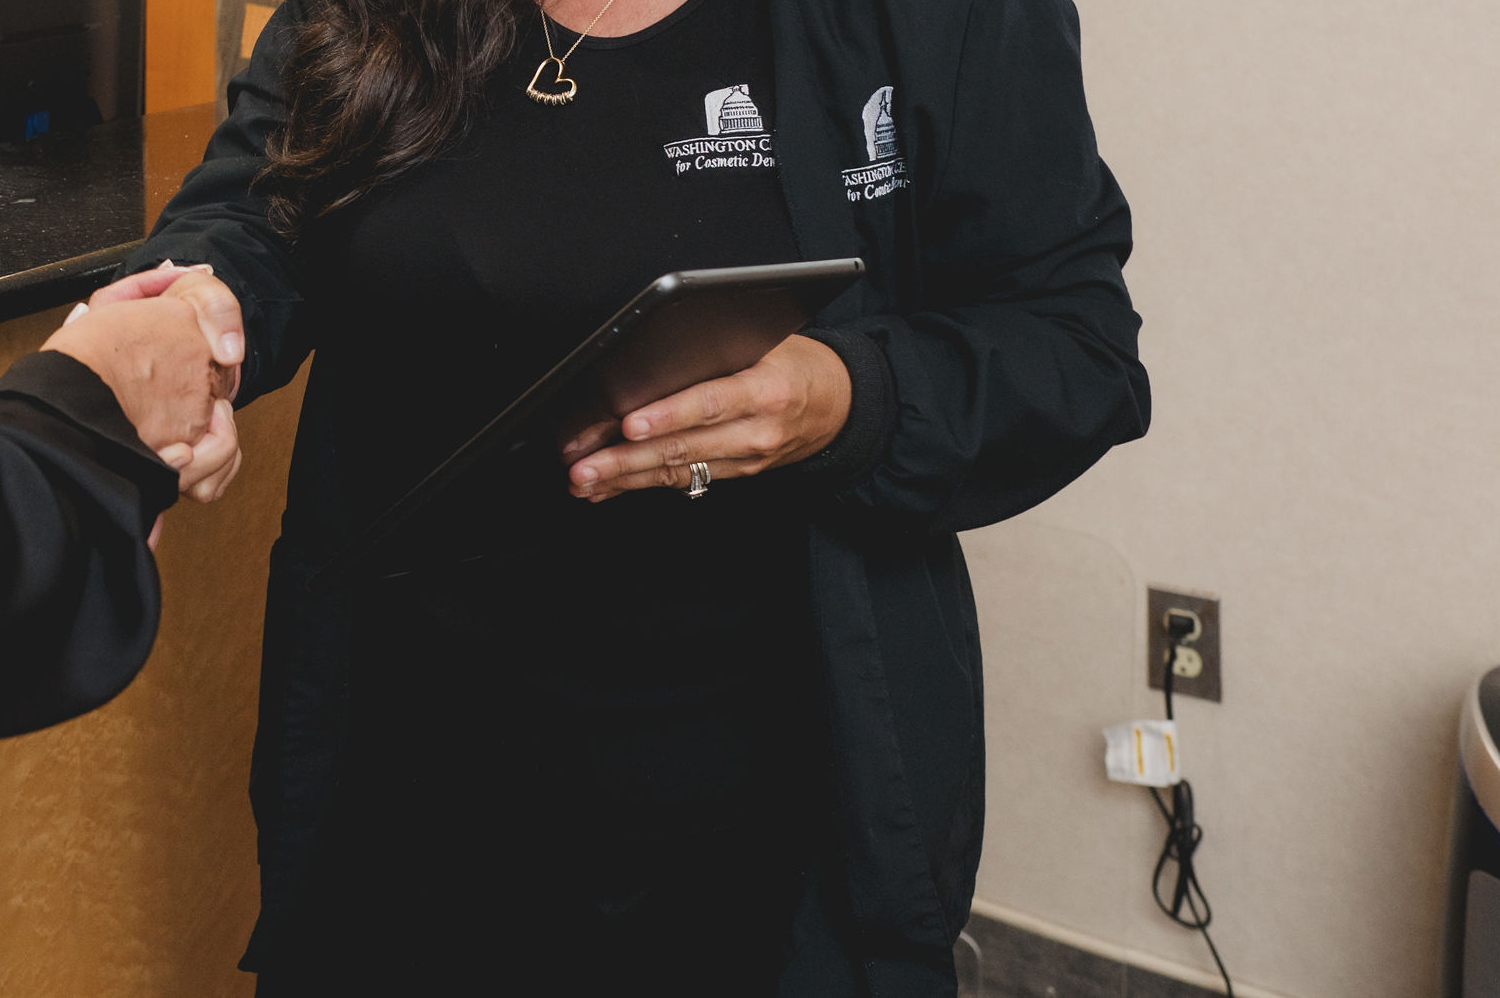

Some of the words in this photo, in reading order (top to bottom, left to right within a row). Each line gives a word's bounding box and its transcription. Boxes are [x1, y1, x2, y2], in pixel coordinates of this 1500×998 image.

[664, 140, 756, 159] WASHINGTON
[676, 160, 691, 176] for
[695, 154, 748, 170] Cosmetic
[842, 165, 894, 186] ASHINGTON
[847, 189, 861, 202] for
